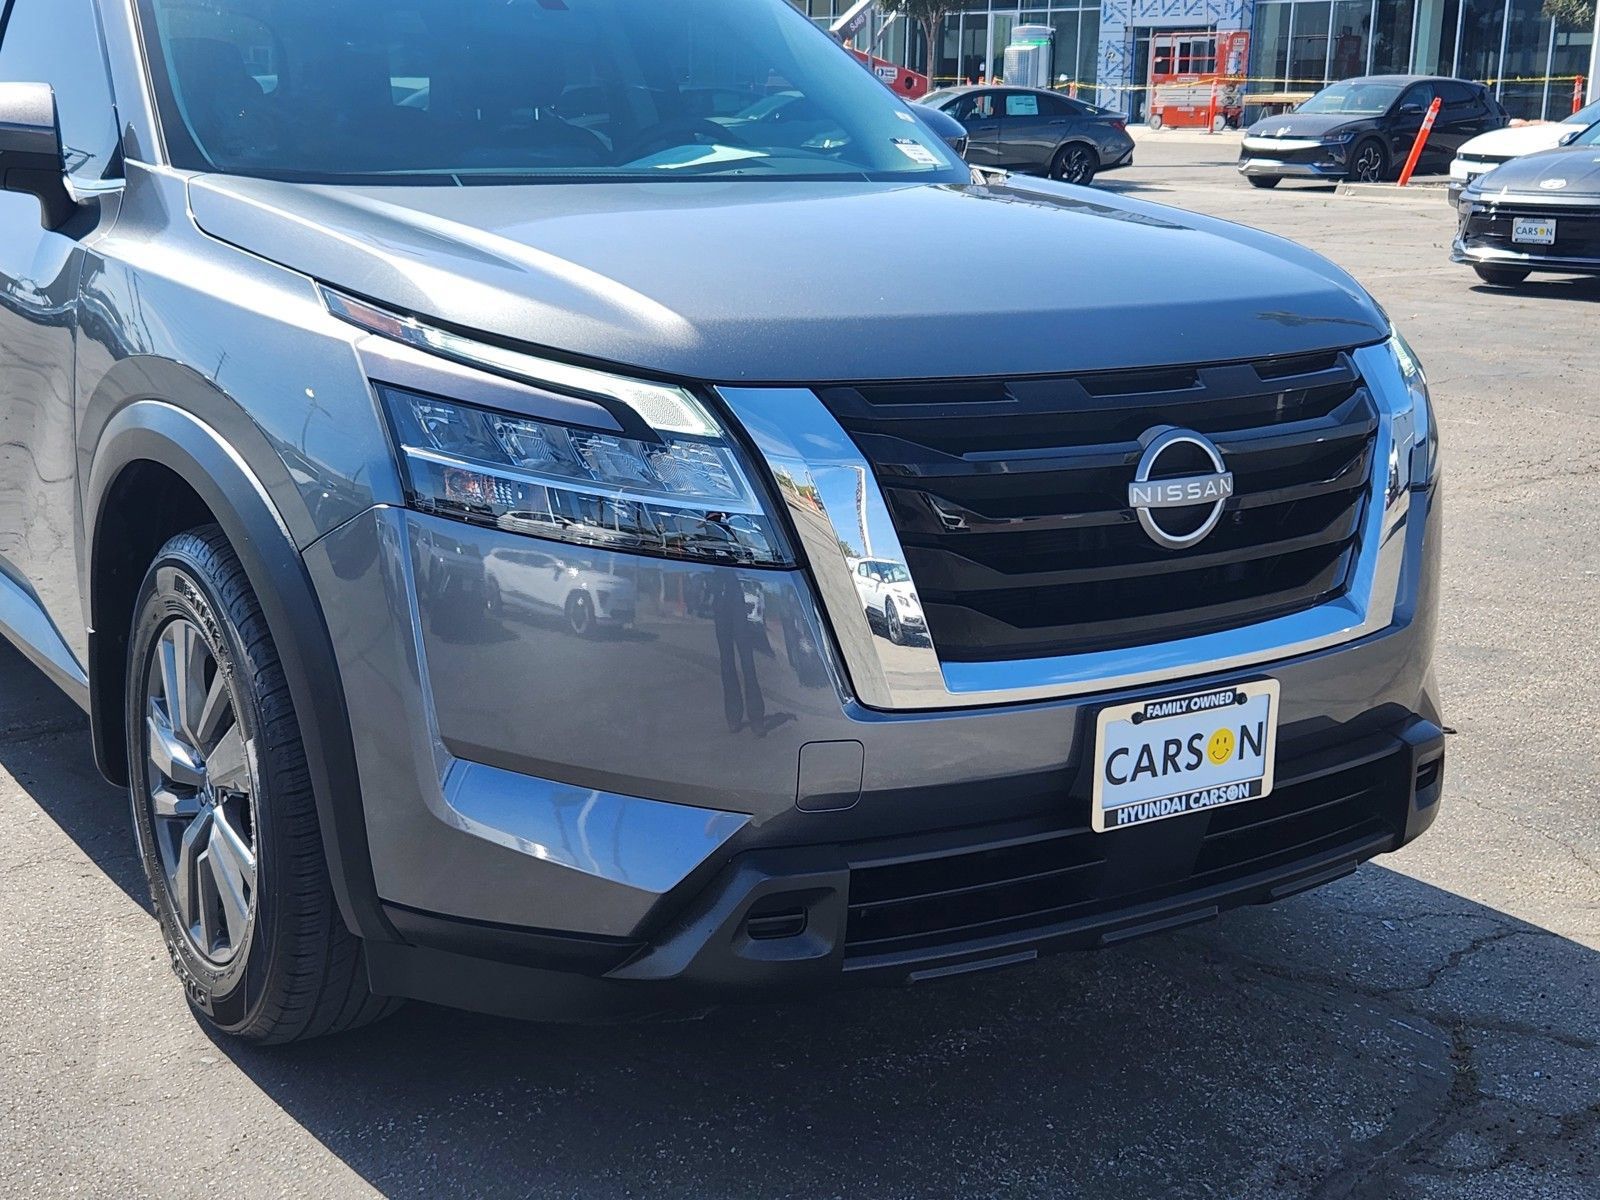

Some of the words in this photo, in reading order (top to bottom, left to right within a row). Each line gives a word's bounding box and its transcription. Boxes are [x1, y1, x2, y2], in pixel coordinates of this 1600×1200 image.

[1132, 477, 1232, 503] NISSAN
[1146, 699, 1189, 718] FAMILY
[1190, 692, 1234, 711] OWNED
[1116, 796, 1186, 825] HYUNDAI
